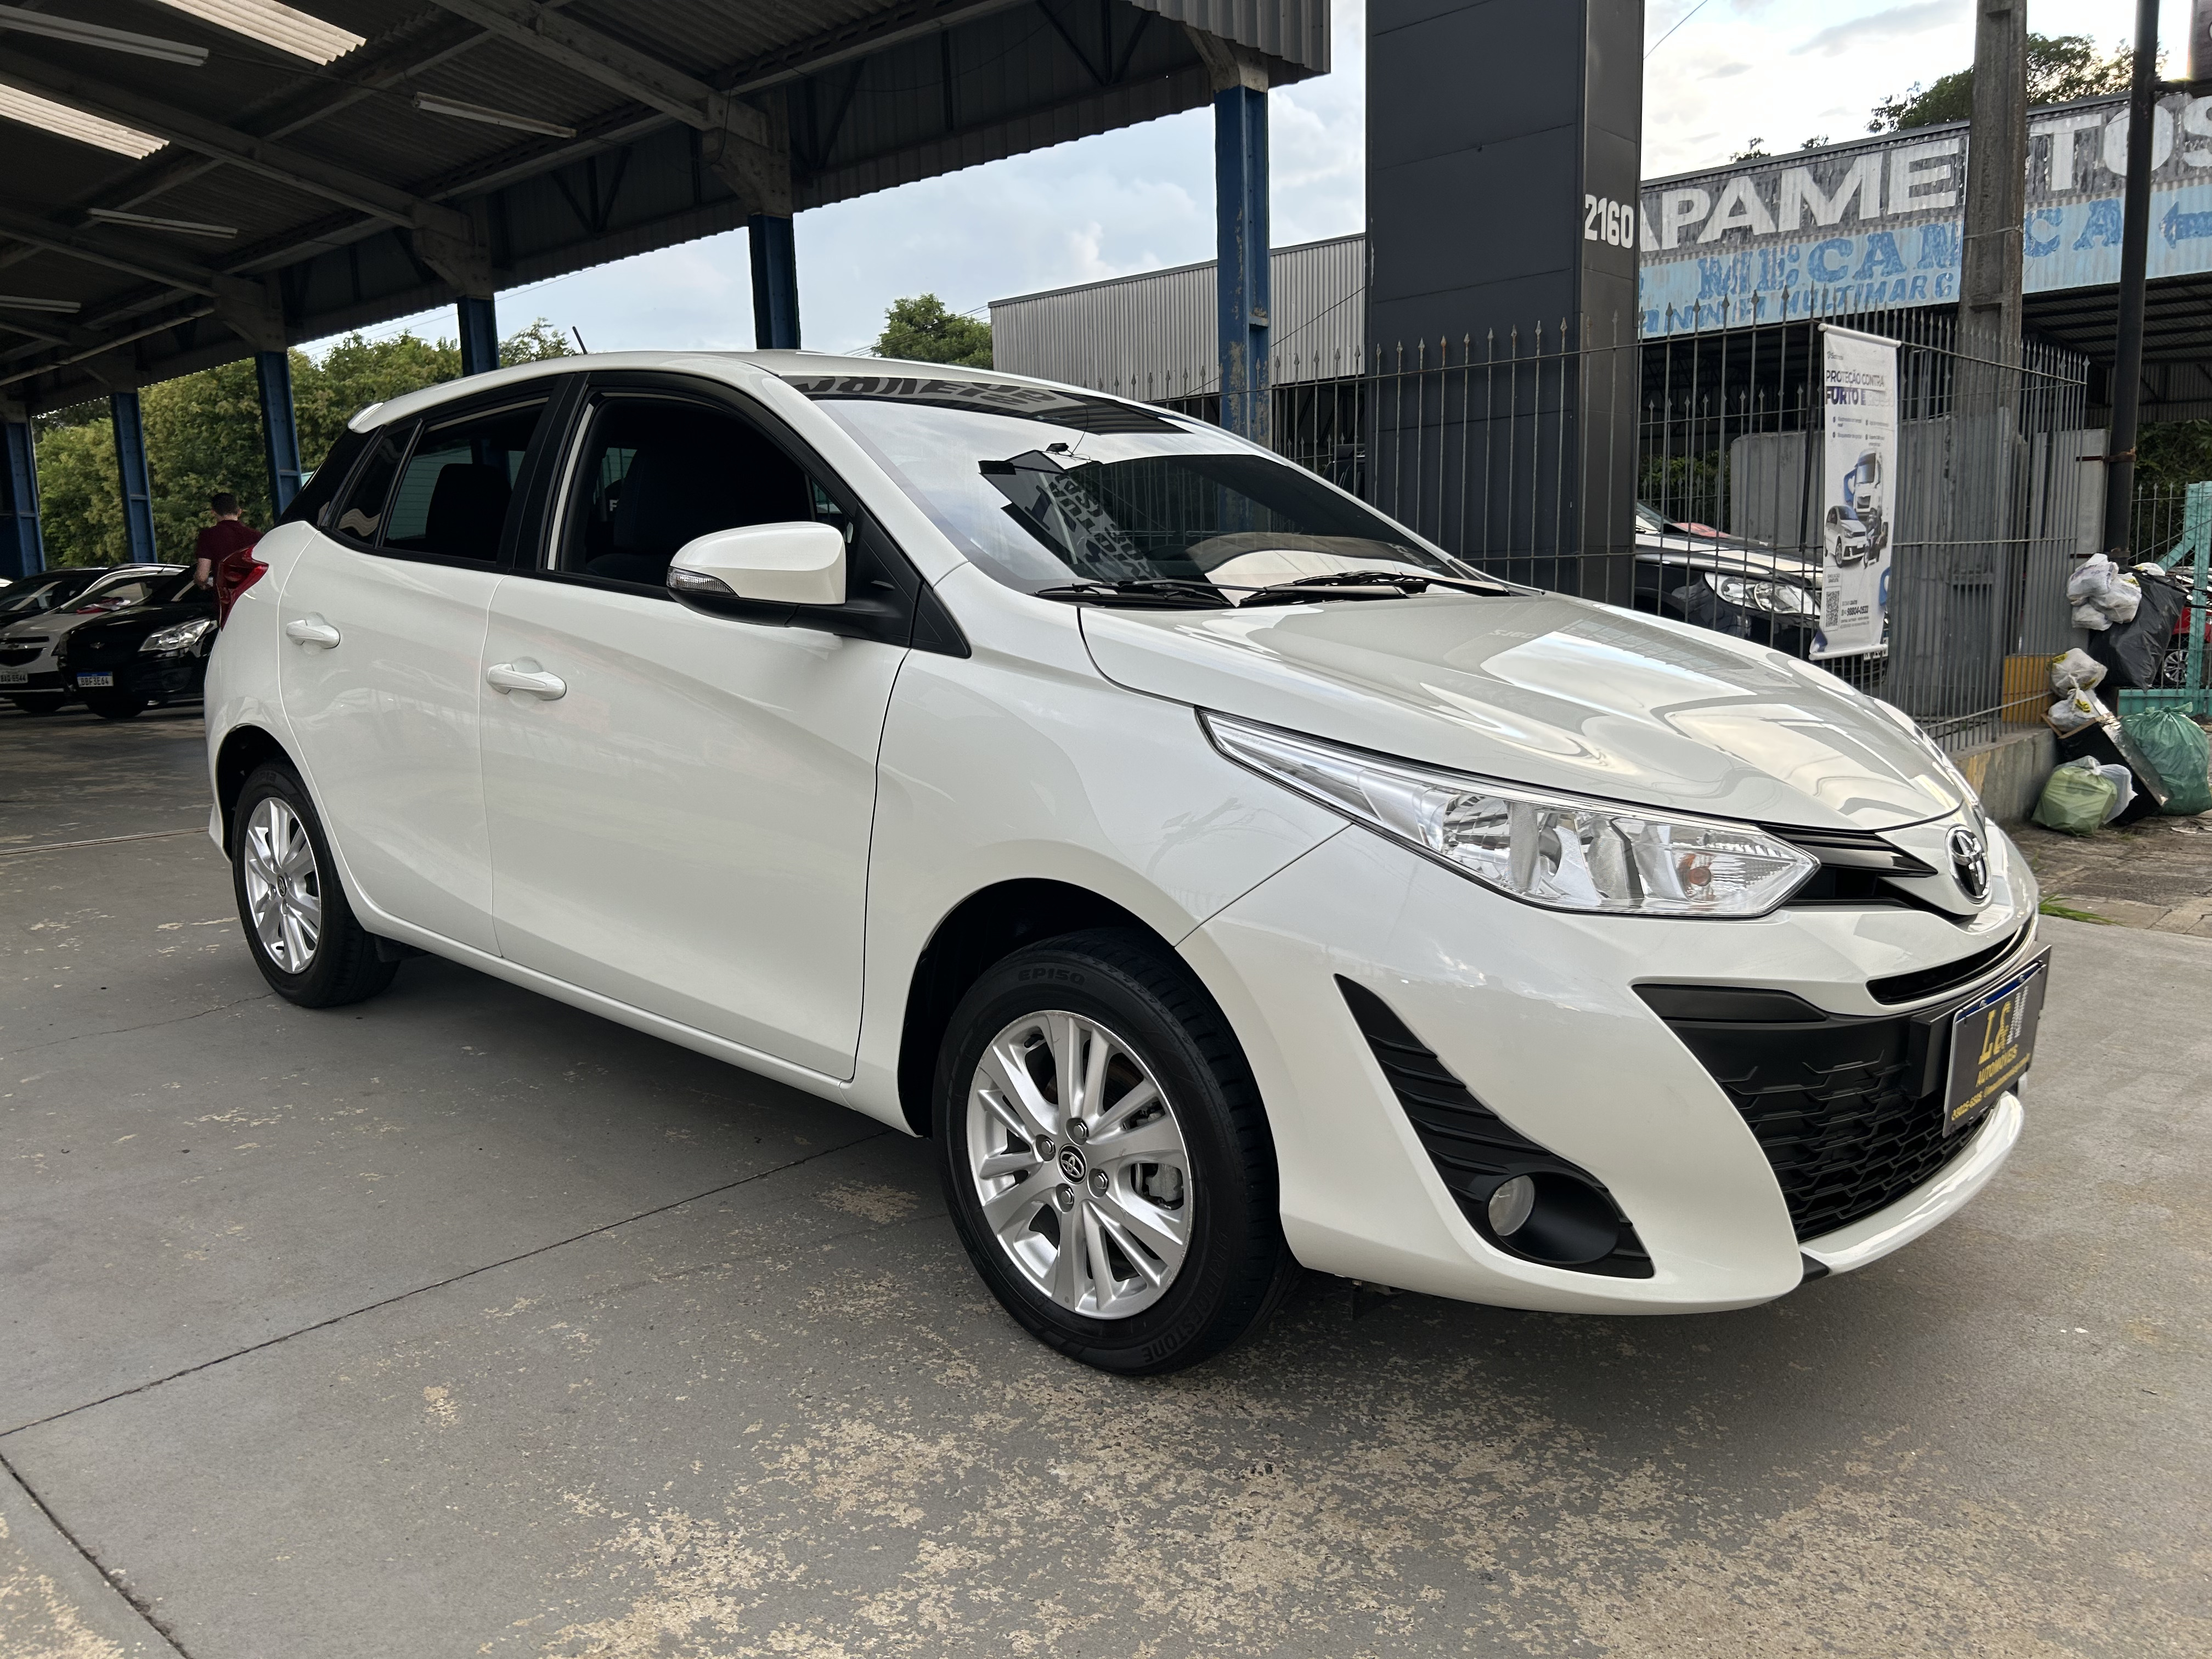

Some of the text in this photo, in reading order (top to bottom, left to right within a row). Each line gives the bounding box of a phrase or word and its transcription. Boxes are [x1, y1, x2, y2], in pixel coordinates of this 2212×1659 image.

[1584, 194, 1634, 249] 2160
[1697, 196, 2124, 301] MECANCA
[1825, 386, 1859, 405] FURTO
[81, 677, 109, 686] BBF3E64
[1017, 967, 1086, 987] EP150
